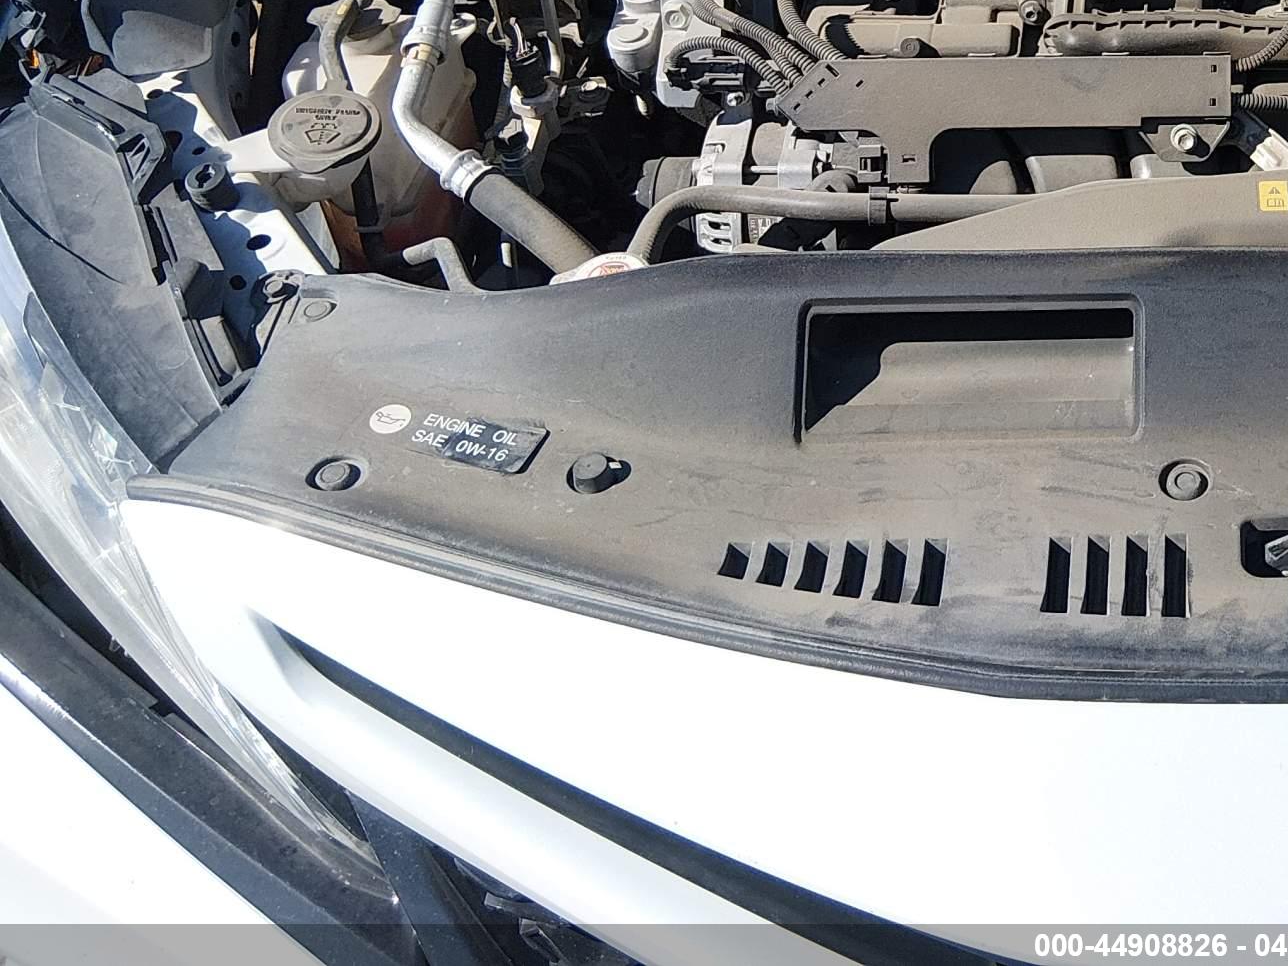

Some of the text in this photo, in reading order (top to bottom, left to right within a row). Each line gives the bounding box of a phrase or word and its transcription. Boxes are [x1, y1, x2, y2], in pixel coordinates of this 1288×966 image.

[411, 429, 509, 462] SAE 0W-16
[423, 413, 518, 446] ENGINE OIL
